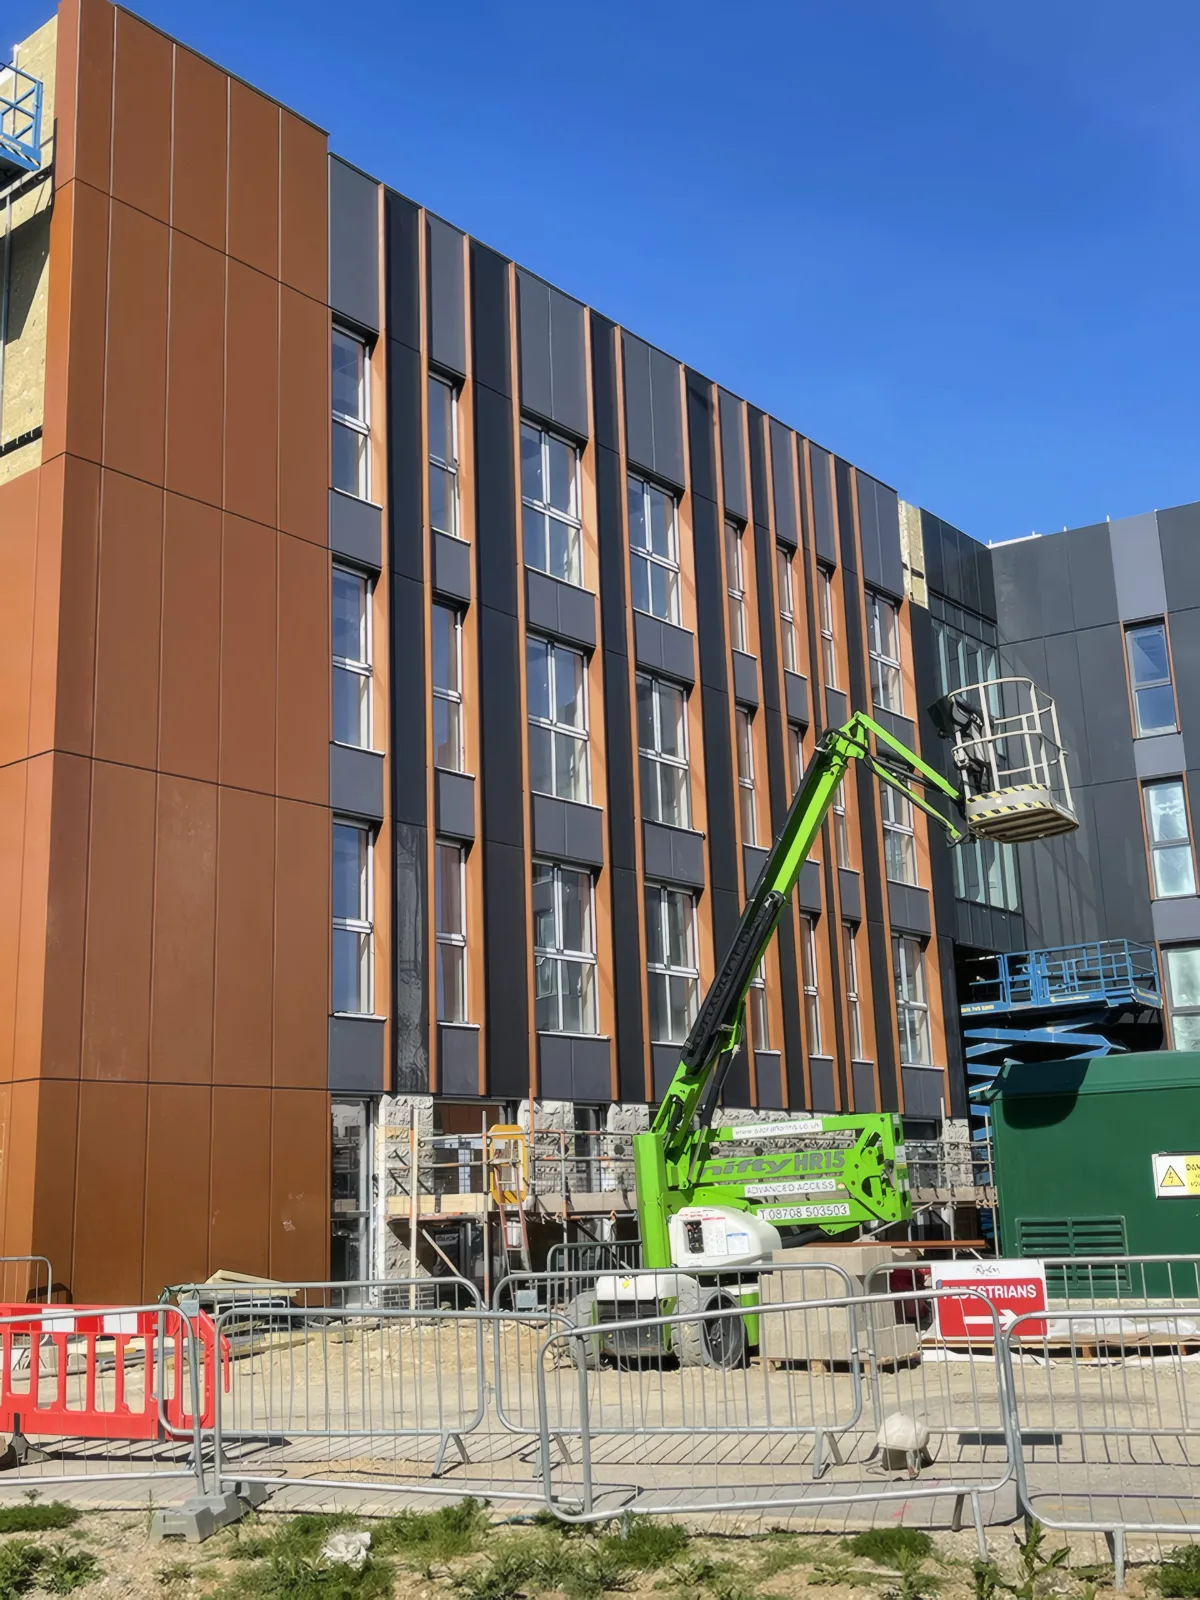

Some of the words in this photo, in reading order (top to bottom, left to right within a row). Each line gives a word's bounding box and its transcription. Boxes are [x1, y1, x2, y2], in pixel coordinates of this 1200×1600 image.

[701, 1158, 792, 1176] nifty
[794, 1151, 845, 1171] HR15
[747, 1183, 795, 1195] ADVANCED
[797, 1180, 835, 1191] ACCESS
[769, 1206, 802, 1219] 08708
[805, 1204, 847, 1216] 503503
